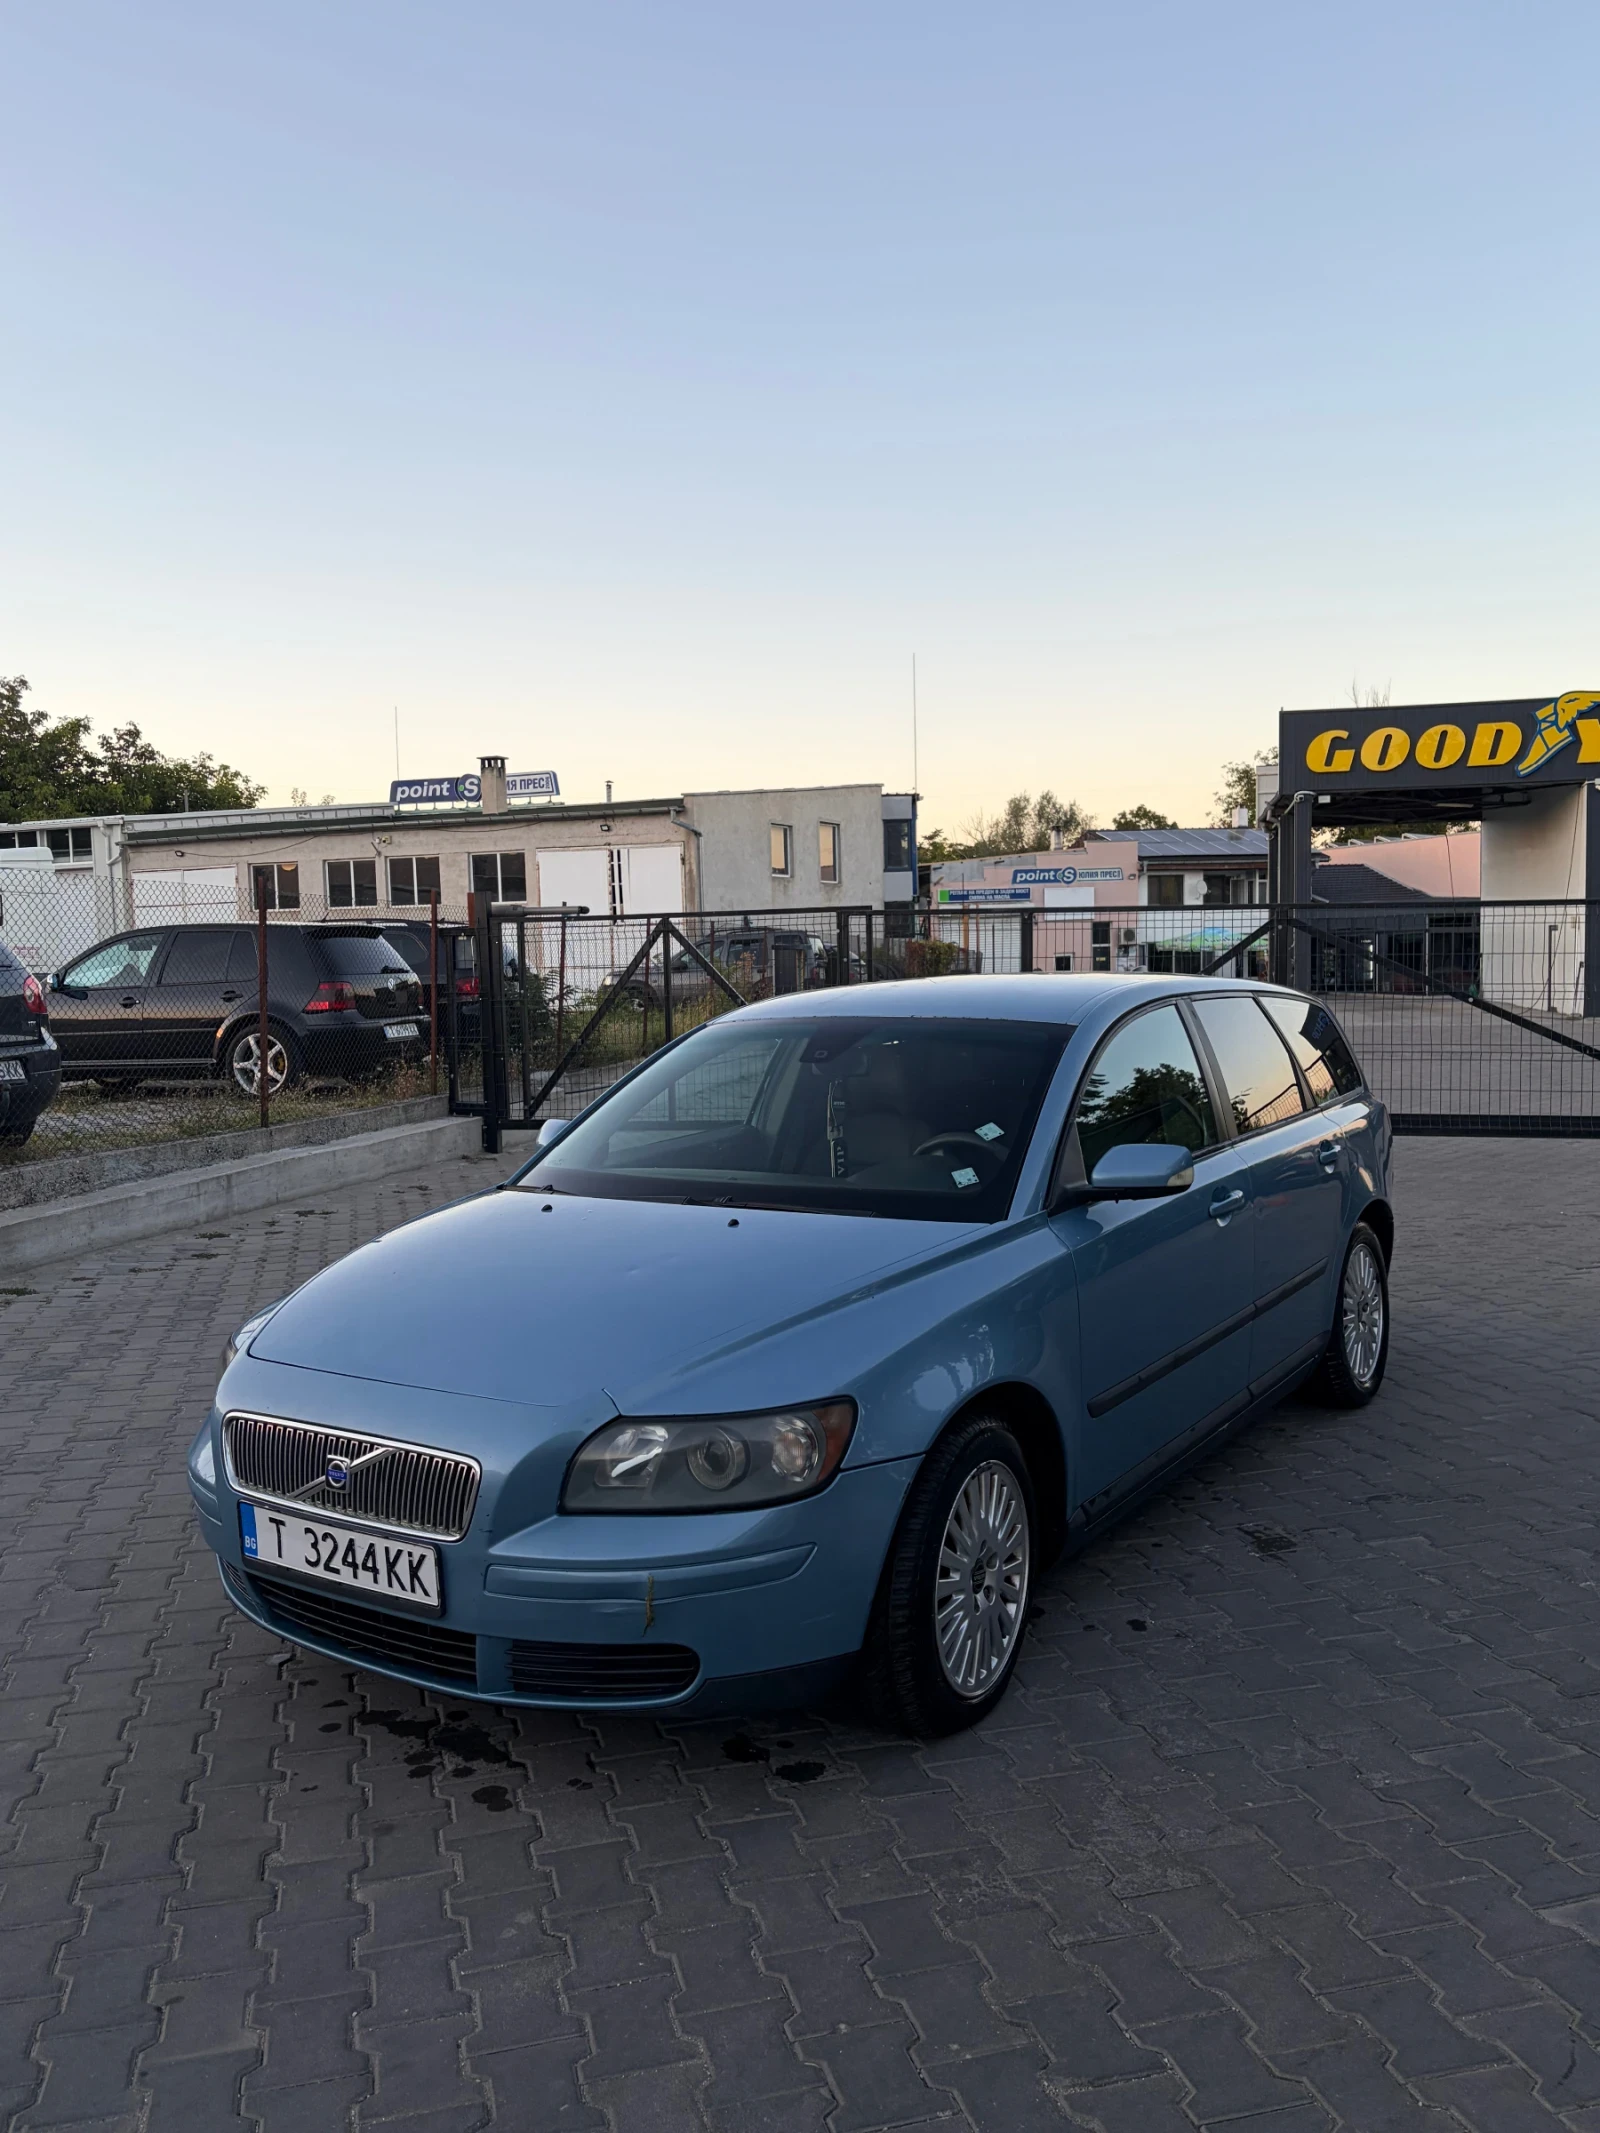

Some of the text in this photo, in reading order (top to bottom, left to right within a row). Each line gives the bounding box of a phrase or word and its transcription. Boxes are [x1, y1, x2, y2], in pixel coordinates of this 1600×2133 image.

[396, 777, 478, 802] point S
[519, 777, 545, 790] ПРЕС
[1016, 869, 1055, 883] point
[245, 1535, 257, 1550] BG
[269, 1517, 431, 1598] T 3244KK
